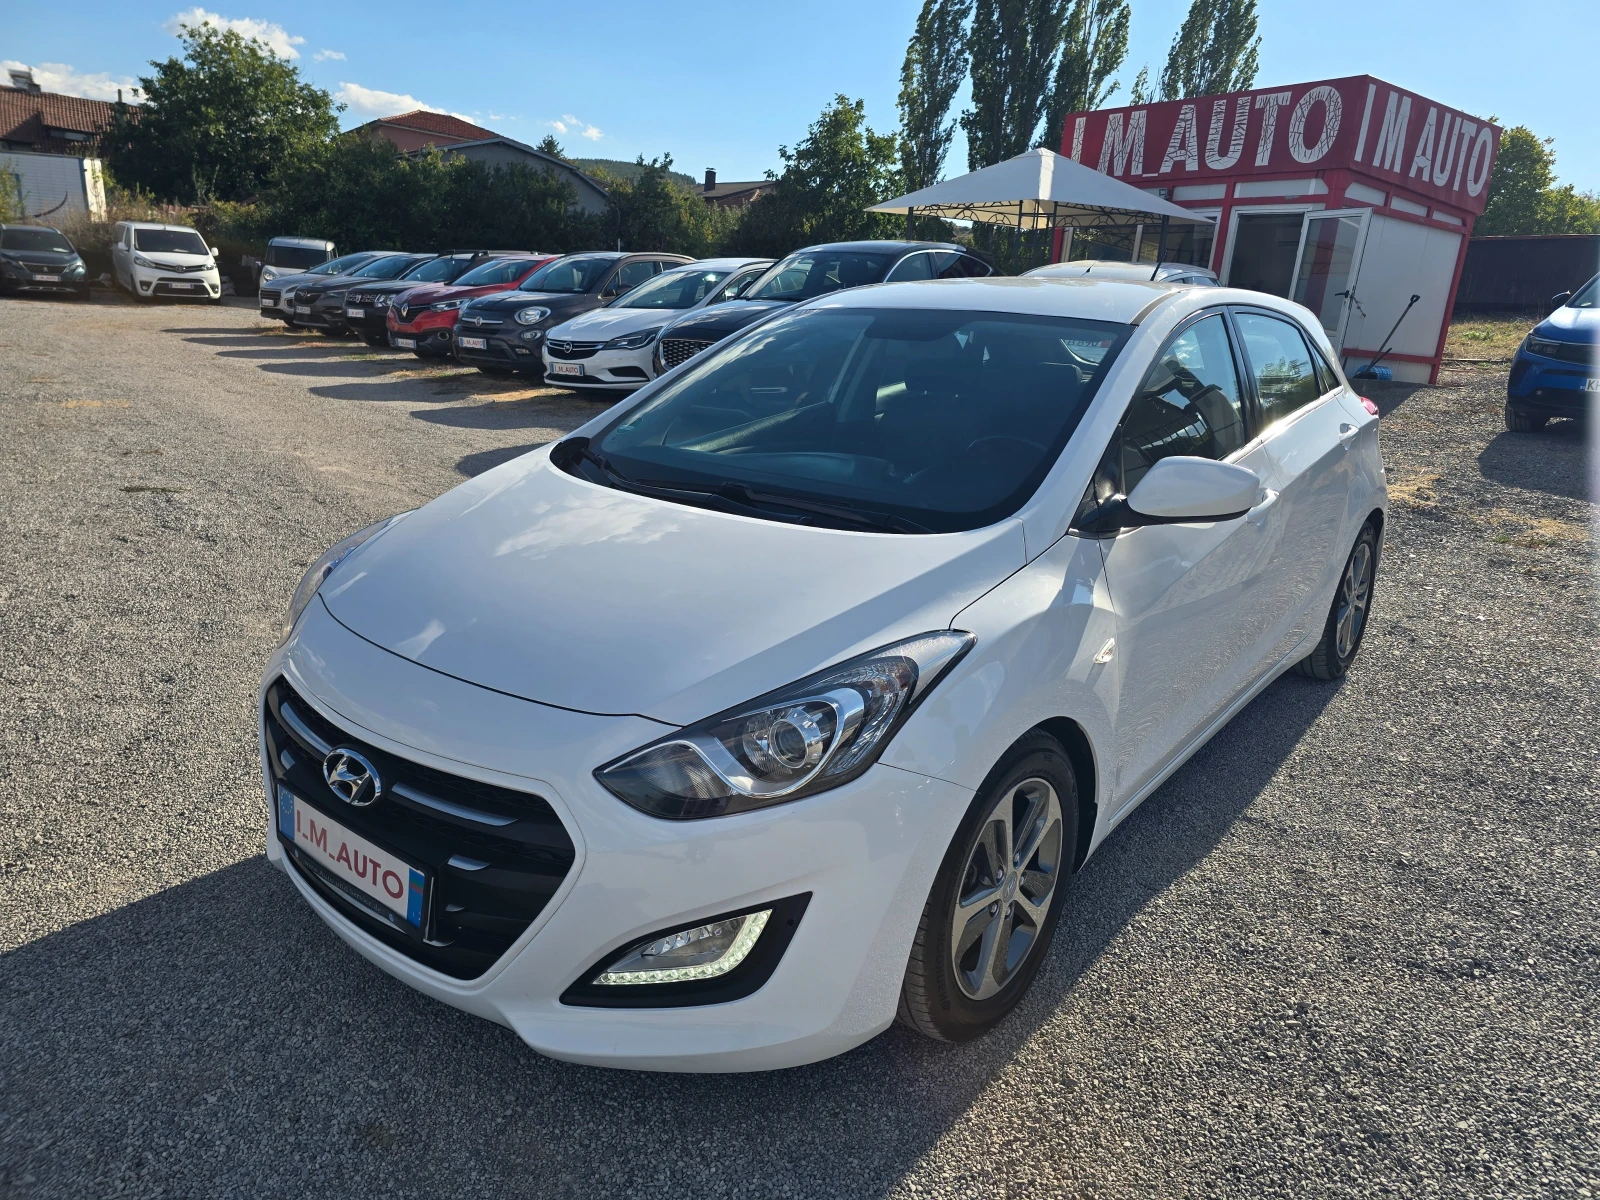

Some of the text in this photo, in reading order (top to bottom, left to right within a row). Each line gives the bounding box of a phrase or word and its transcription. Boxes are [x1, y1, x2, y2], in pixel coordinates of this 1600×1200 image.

[1354, 83, 1493, 197] I M AUTO
[296, 809, 404, 899] I_M_AUTO
